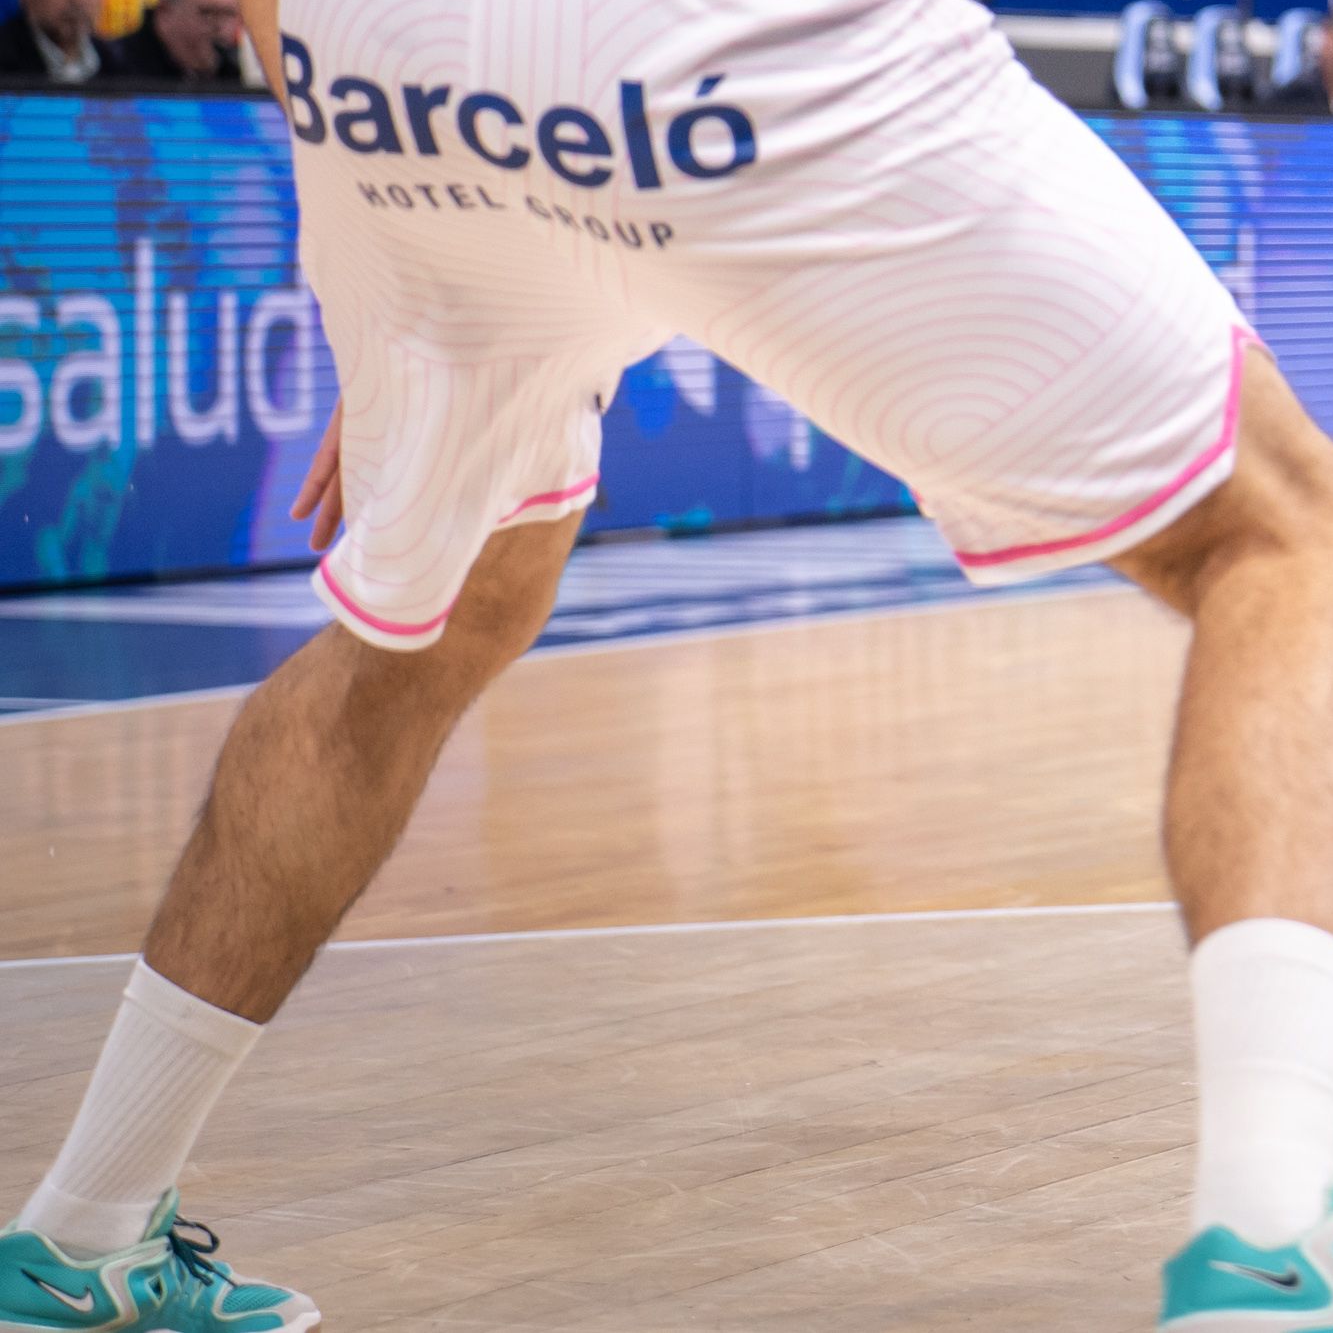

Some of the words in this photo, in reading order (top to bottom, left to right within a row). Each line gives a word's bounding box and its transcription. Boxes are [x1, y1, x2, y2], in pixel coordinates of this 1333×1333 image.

[281, 32, 758, 191] Barceló
[357, 182, 505, 210] HOTEL
[525, 194, 674, 250] GROUP
